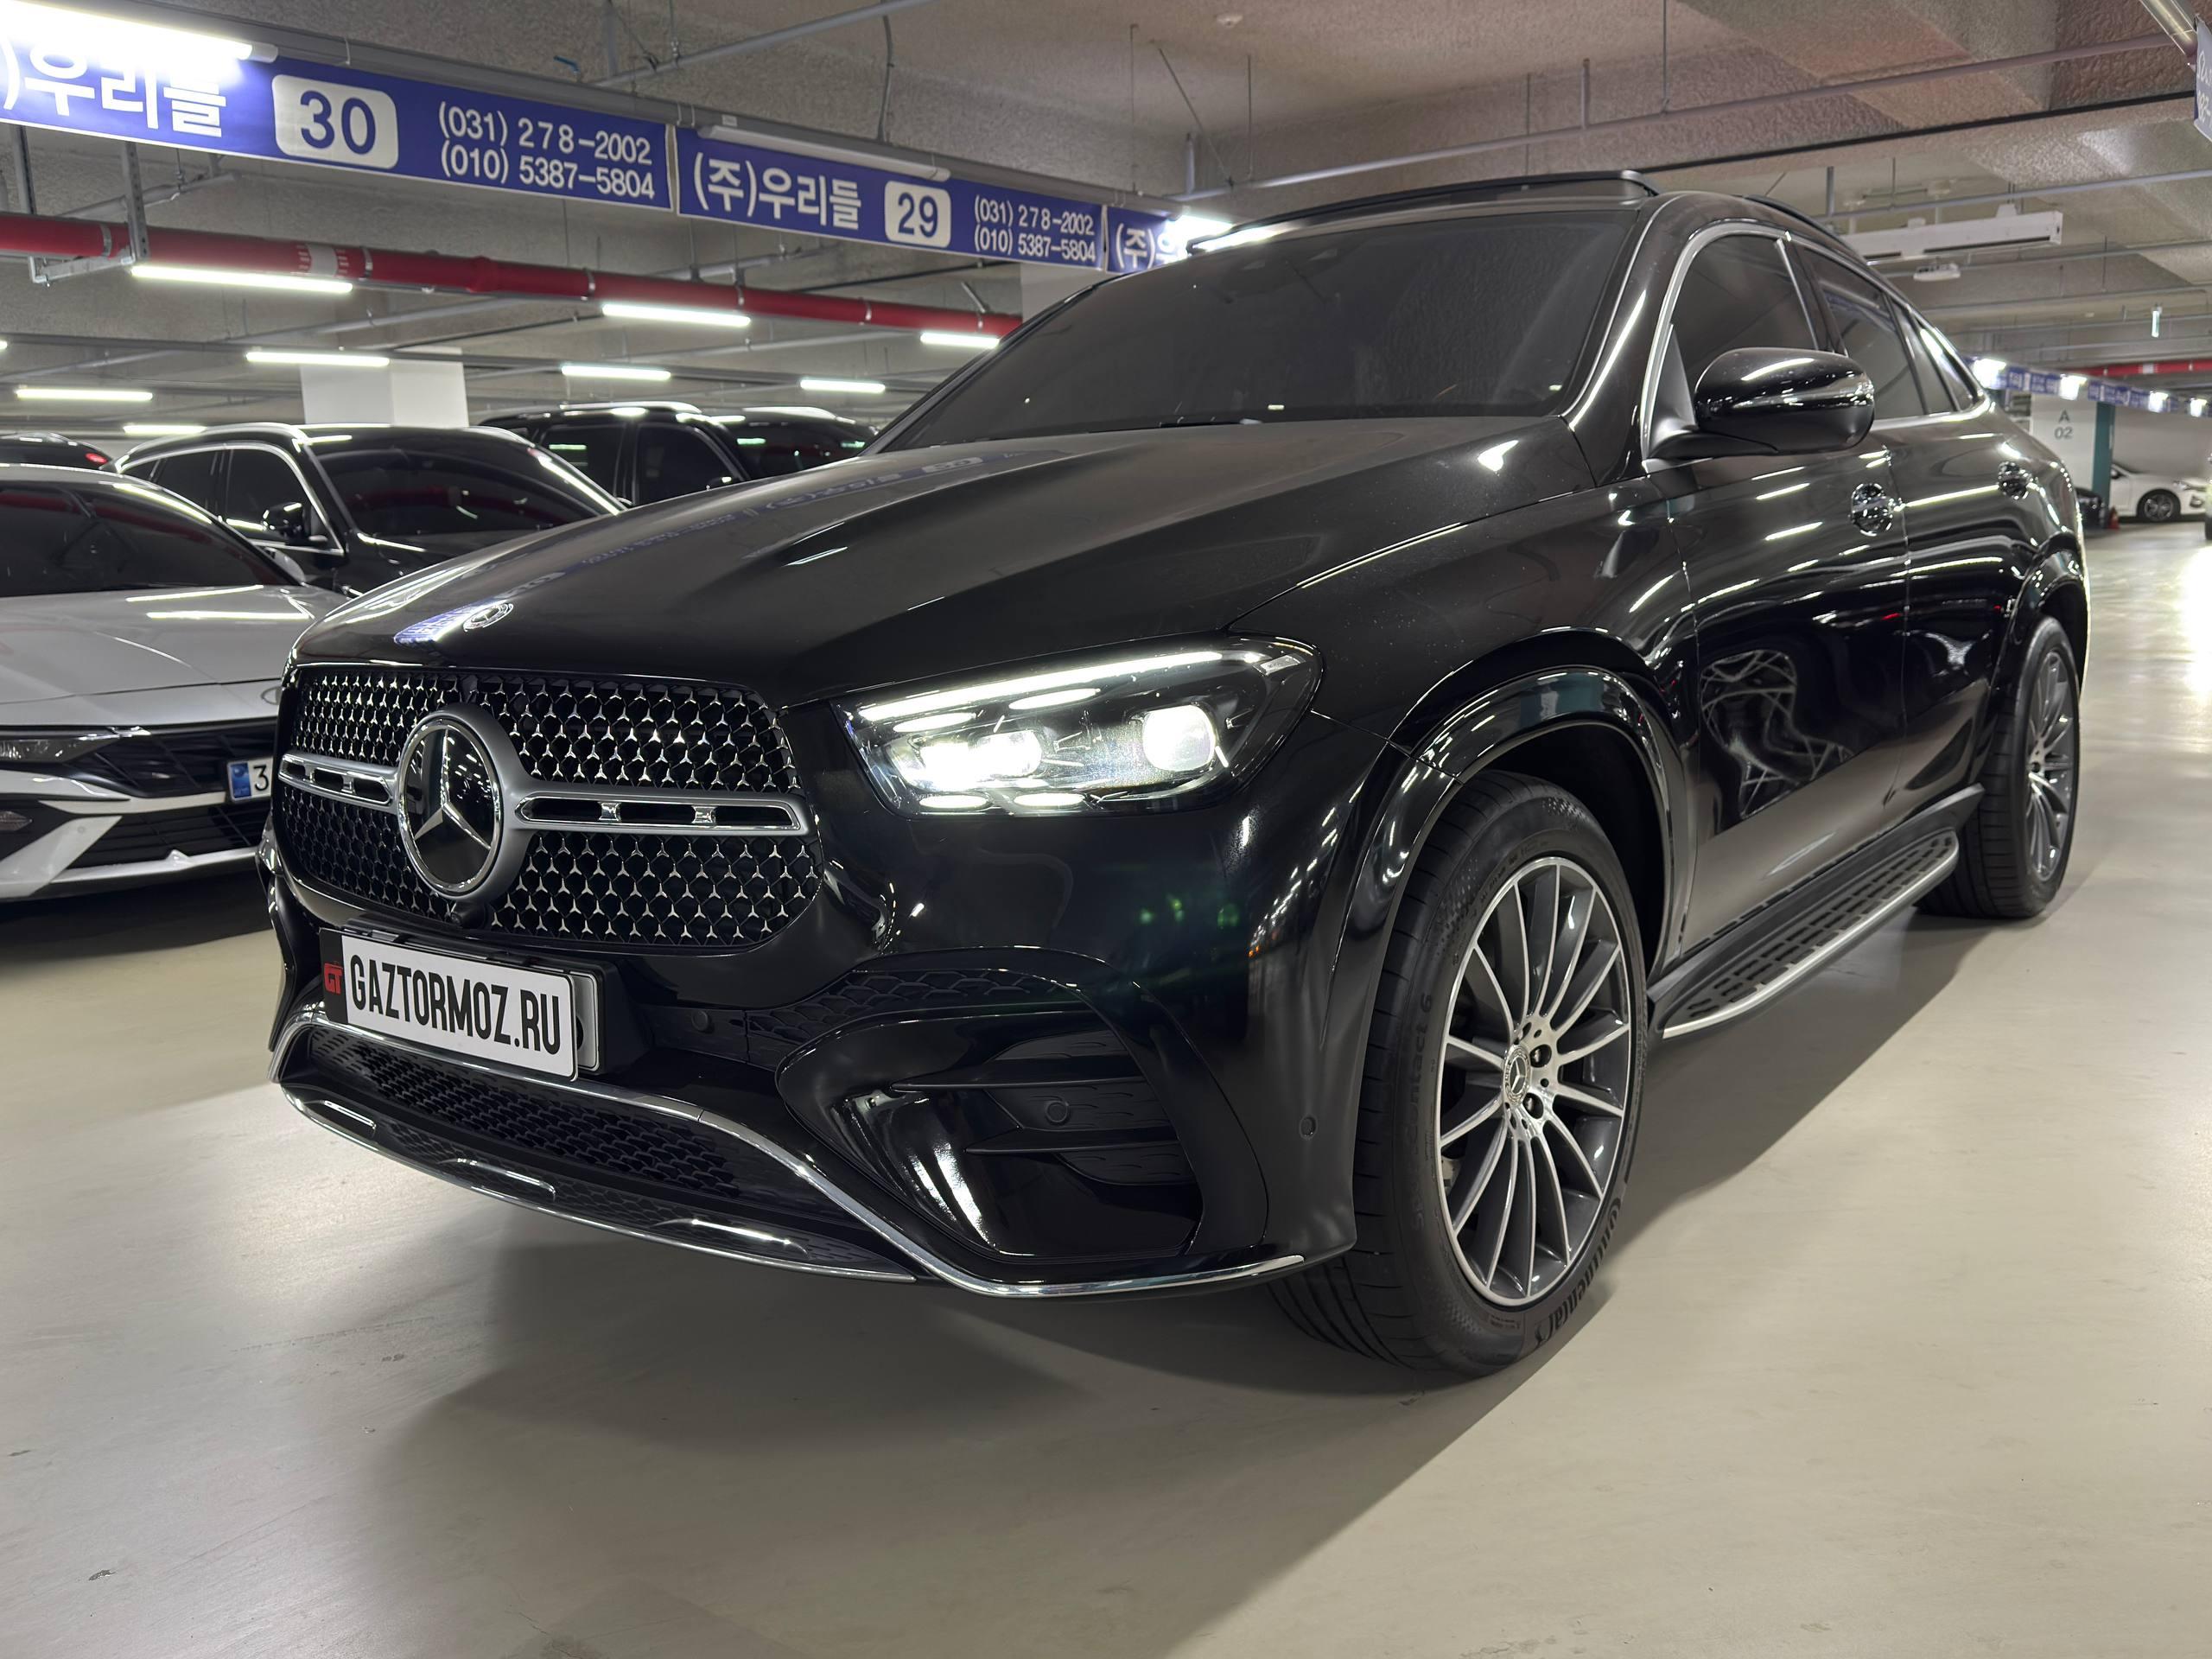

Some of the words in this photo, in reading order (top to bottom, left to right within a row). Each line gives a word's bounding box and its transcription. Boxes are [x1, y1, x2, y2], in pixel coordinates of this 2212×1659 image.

[300, 90, 376, 155] 30
[439, 101, 508, 146] (031)
[518, 118, 652, 165] 278-2002
[442, 140, 509, 184] (010)
[519, 156, 655, 200] 5387-5804
[694, 152, 861, 230] (주)우리들
[898, 192, 938, 238] 29
[975, 194, 1013, 227] (031)
[1018, 204, 1095, 235] 278-2002
[975, 224, 1013, 256] (010)
[1018, 232, 1096, 262] 5387-5804
[2054, 426, 2073, 439] 02
[2058, 410, 2070, 423] A
